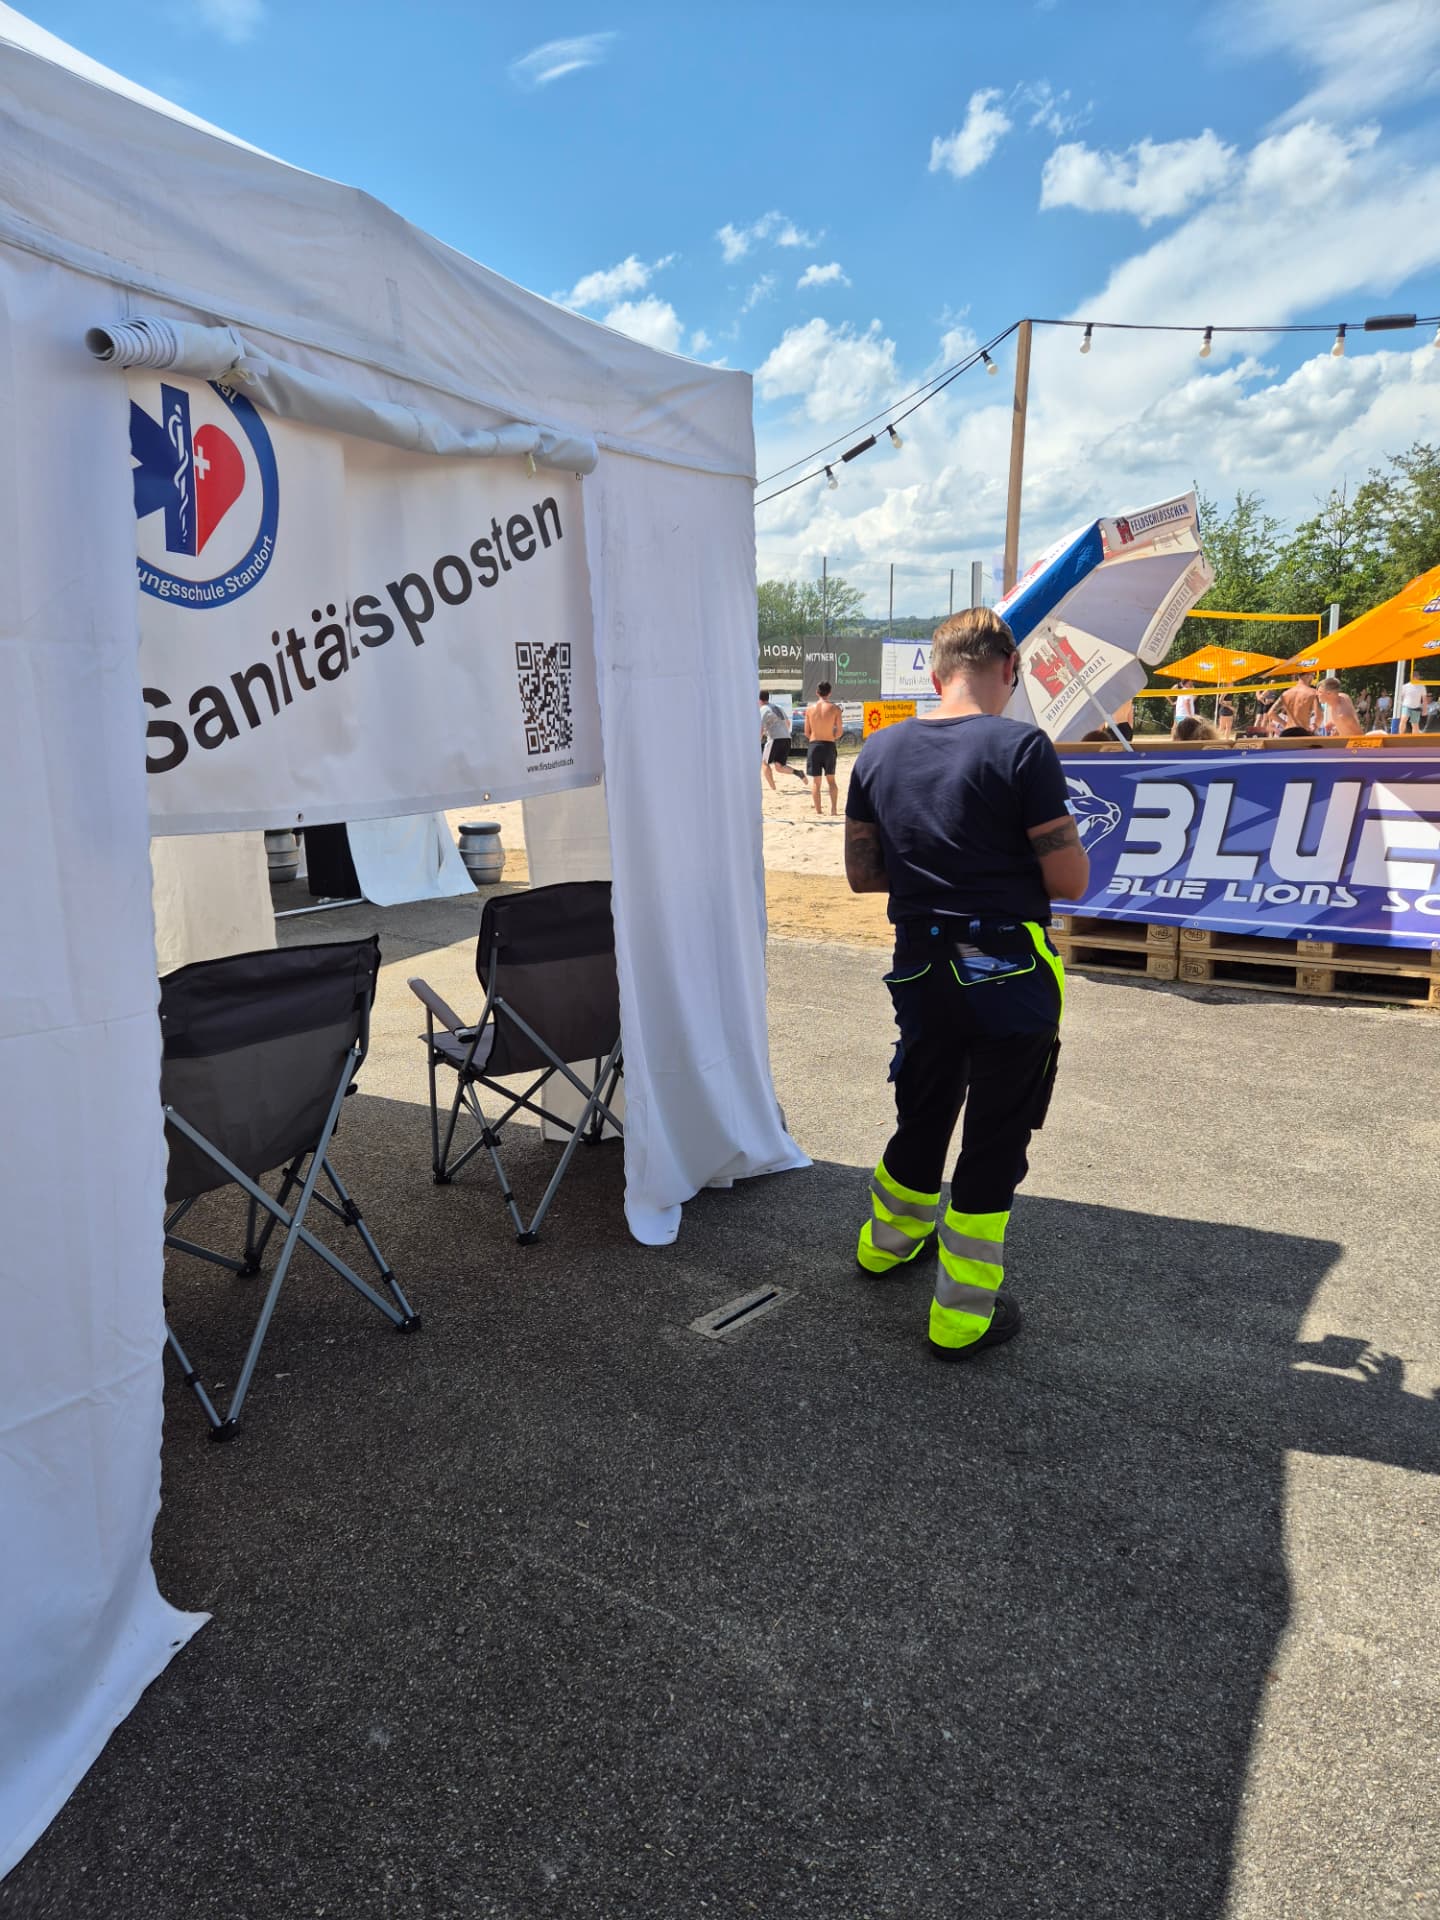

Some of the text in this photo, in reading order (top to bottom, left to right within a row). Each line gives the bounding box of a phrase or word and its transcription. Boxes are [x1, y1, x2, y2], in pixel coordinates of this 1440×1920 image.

[224, 535, 273, 594] Standort
[1115, 782, 1440, 890] BLUE
[1107, 878, 1207, 900] BLUE
